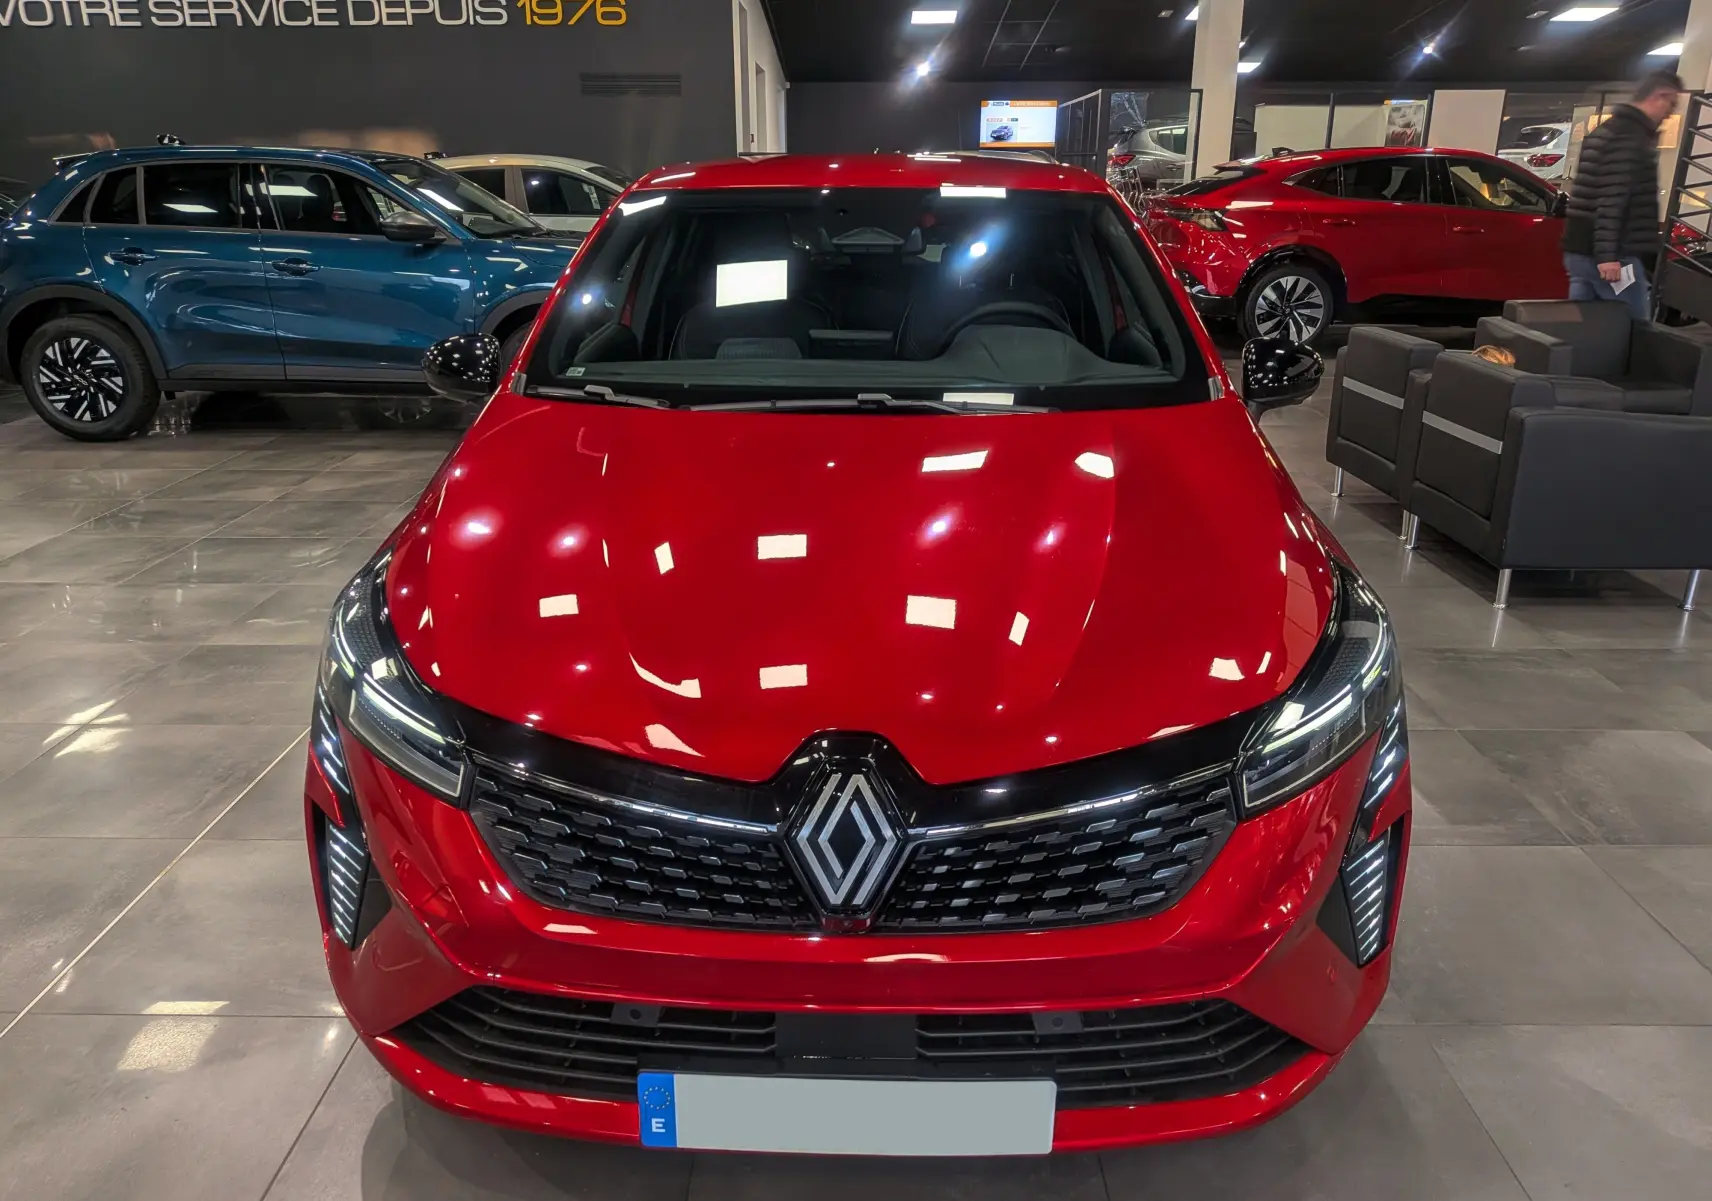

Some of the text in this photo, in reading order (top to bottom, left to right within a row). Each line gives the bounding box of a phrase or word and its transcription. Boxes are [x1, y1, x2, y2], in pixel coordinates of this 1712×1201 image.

[0, 0, 627, 27] VOTRE SERVICE DEPUIS 1976
[651, 1117, 666, 1133] E
